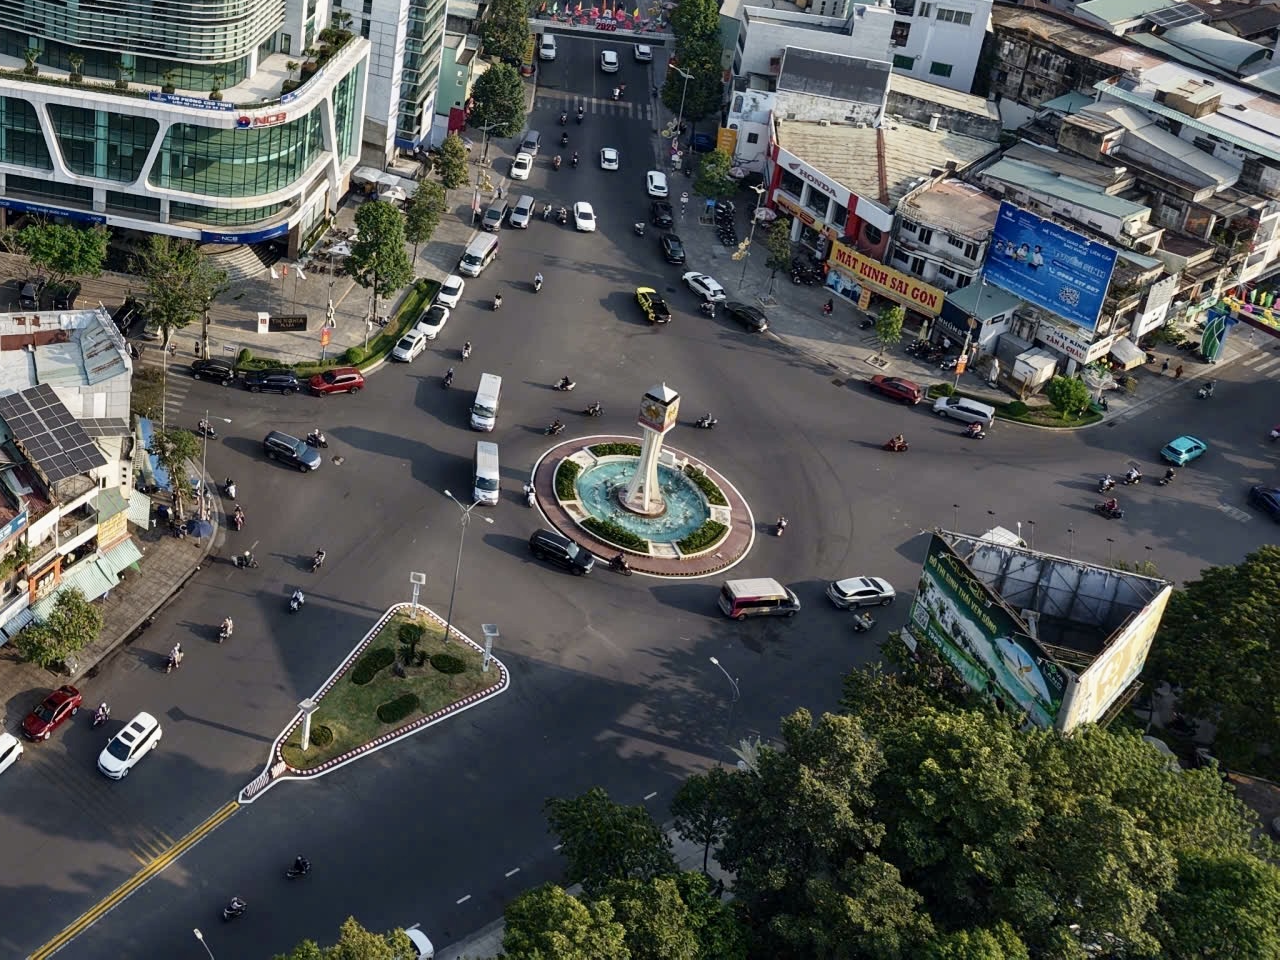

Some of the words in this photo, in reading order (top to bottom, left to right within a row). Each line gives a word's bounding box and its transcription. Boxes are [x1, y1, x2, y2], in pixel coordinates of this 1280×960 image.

[595, 22, 617, 32] 2026
[254, 112, 287, 125] NCB
[799, 168, 837, 198] HONDA
[835, 248, 859, 270] MẮT
[860, 261, 889, 286] KÍNH
[911, 286, 938, 308] GÒN
[1069, 338, 1087, 352] KÍNH
[945, 573, 959, 592] SINH
[958, 587, 971, 605] THÁI
[970, 601, 983, 617] VEN
[981, 613, 998, 634] SÔNG
